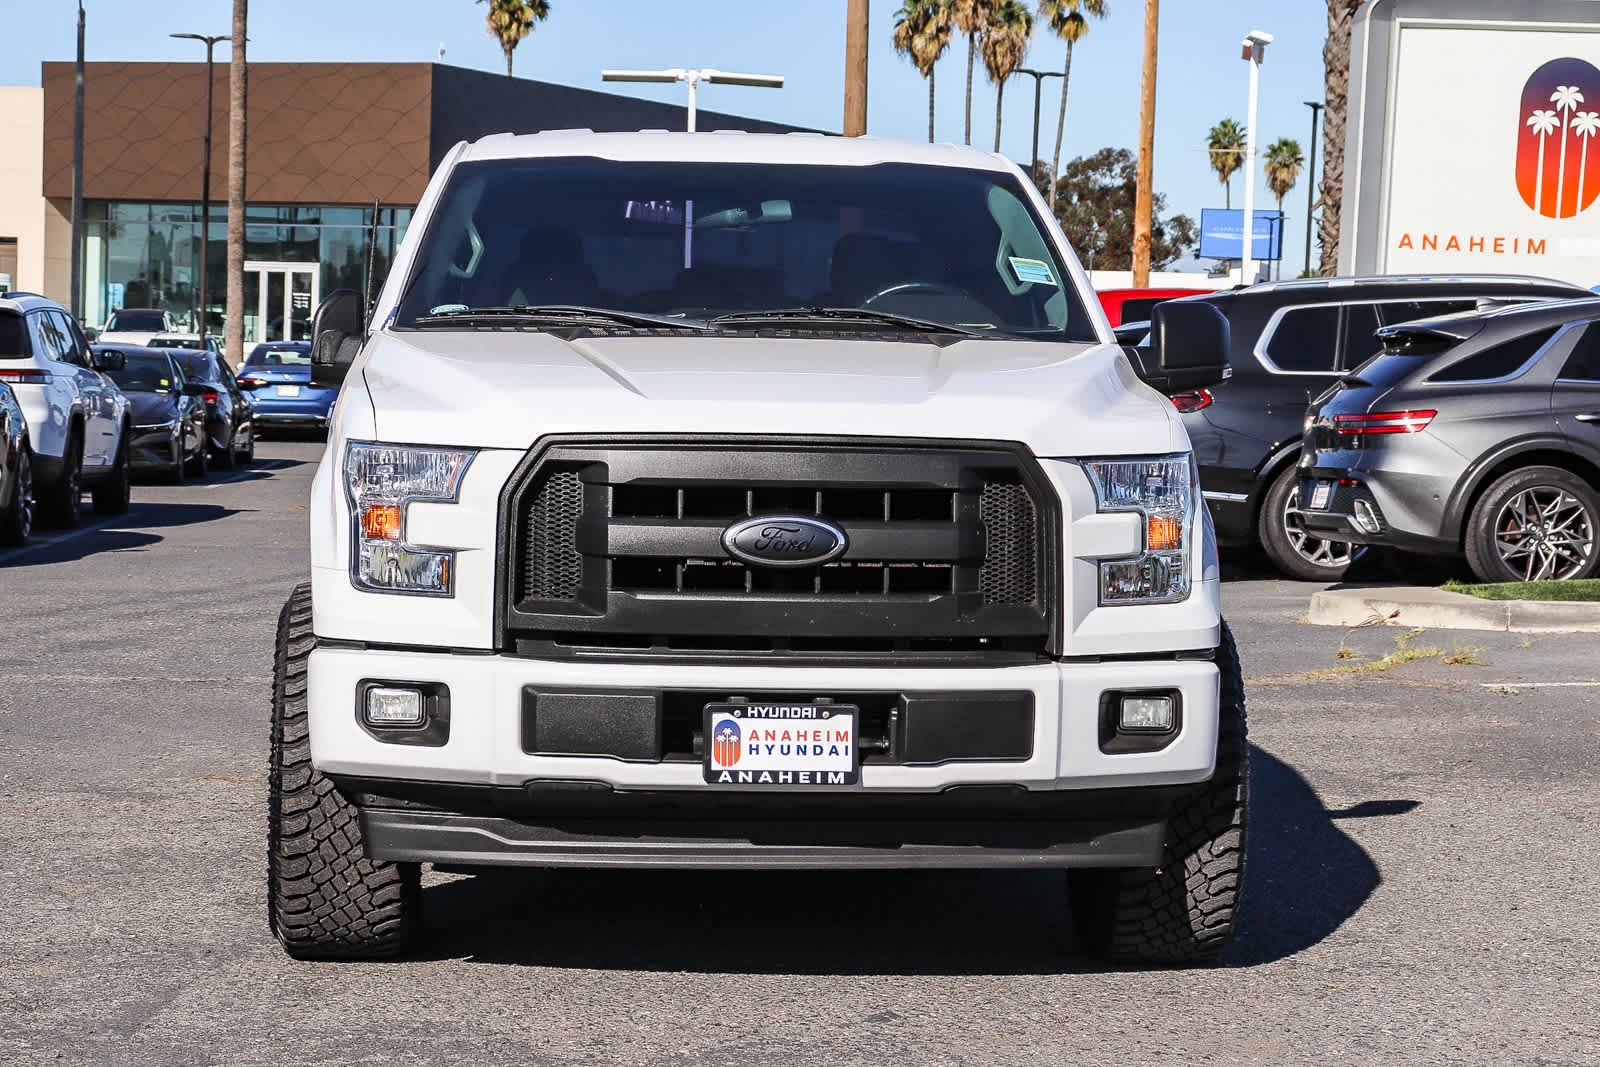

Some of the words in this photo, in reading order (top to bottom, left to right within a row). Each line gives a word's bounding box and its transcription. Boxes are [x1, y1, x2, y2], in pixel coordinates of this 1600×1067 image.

[1398, 233, 1547, 255] ANAHEIM
[754, 526, 816, 552] Ford
[747, 706, 817, 719] HYUNDAI
[749, 730, 849, 742] ANAHEIM
[749, 744, 849, 756] HYUNDAI
[718, 771, 845, 784] ANAHEIM
